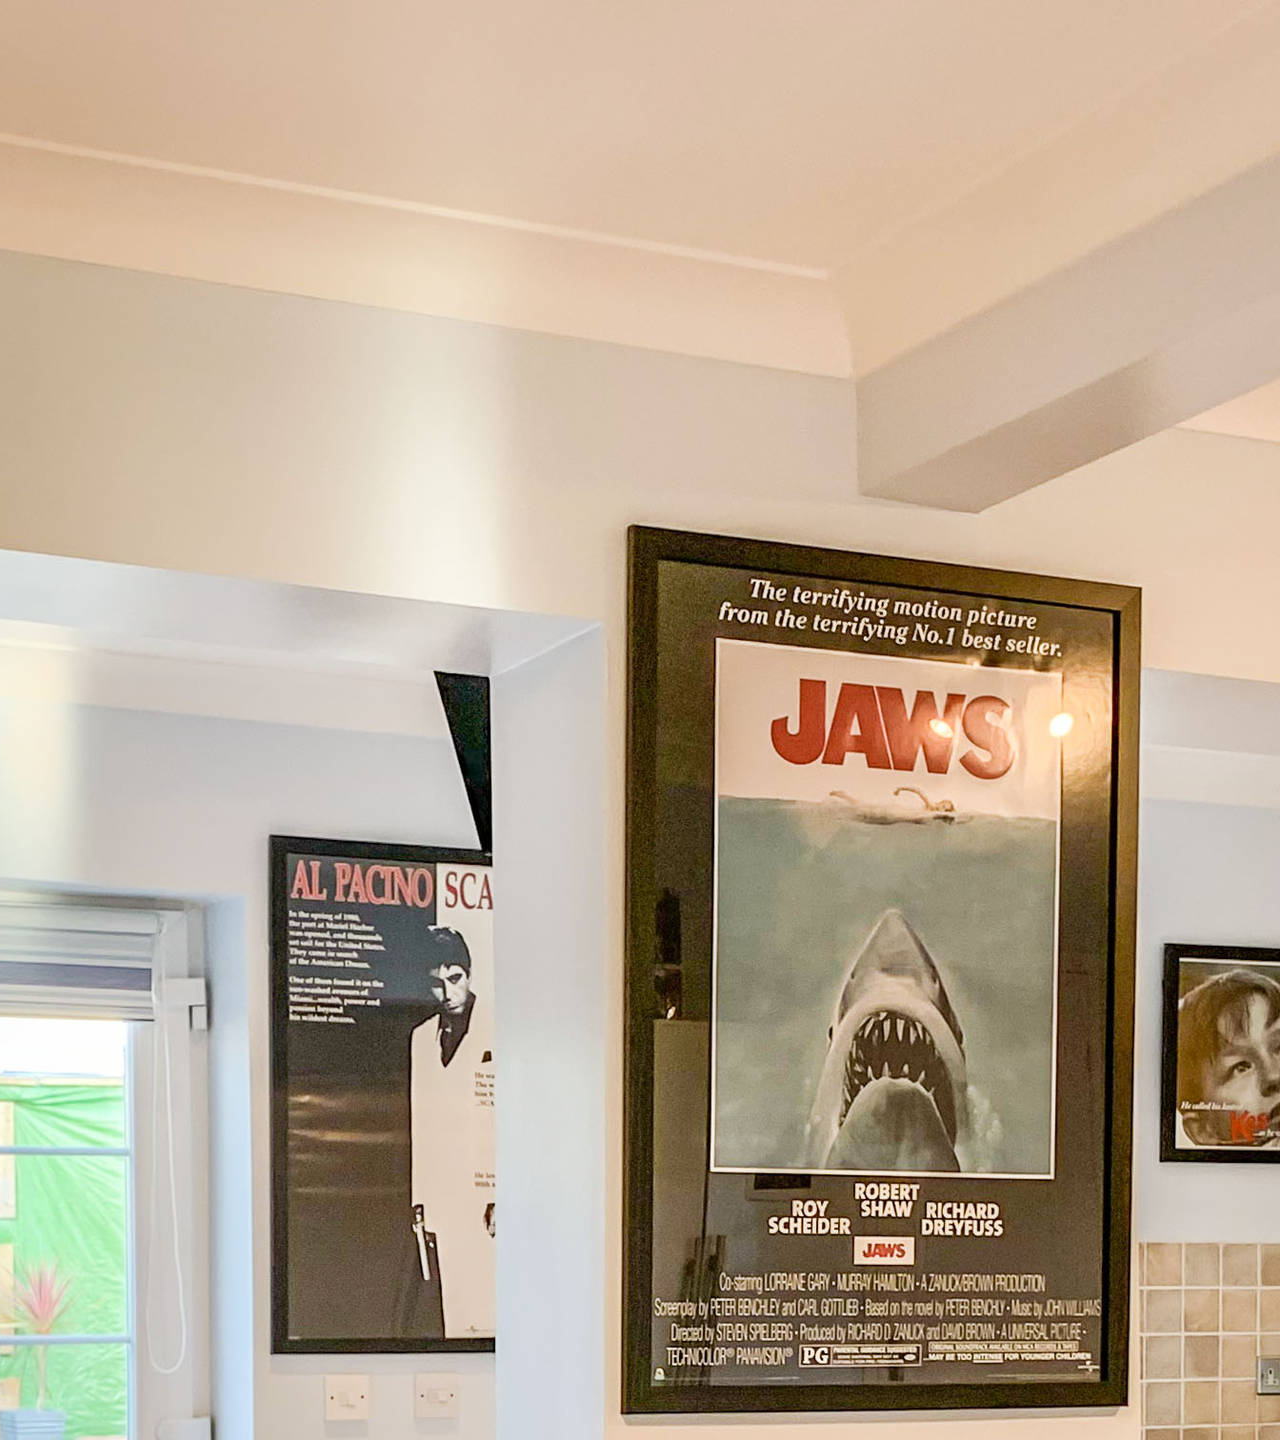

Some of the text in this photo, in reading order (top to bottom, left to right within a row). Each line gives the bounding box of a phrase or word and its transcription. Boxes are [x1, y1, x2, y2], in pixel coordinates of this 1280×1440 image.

[750, 578, 1037, 629] The terrifying motion picture
[718, 601, 1062, 657] from the terrifying No.1 best seller.
[771, 678, 1016, 780] JAWS
[291, 860, 434, 908] AL PACINO
[854, 1183, 920, 1200] ROBERT
[791, 1200, 829, 1217] ROY
[860, 1200, 913, 1217] SHAW
[926, 1202, 1000, 1220] RICHARD
[768, 1217, 851, 1235] SCHEIDER
[921, 1219, 1004, 1236] DREYFUSS
[862, 1243, 906, 1258] JAWS
[719, 1272, 763, 1294] Co-starring
[764, 1272, 806, 1292] LORRAINE
[807, 1272, 830, 1292] GARY
[837, 1272, 872, 1292] MURRAY
[873, 1273, 914, 1292] HAMILTON
[920, 1273, 927, 1292] A
[995, 1273, 1046, 1292] PRODUCTION
[654, 1298, 696, 1319] Screenplay
[698, 1299, 709, 1319] by
[710, 1298, 736, 1316] PETER
[737, 1298, 780, 1316] BENCHLEY
[782, 1299, 796, 1316] and
[797, 1298, 819, 1316] CARL
[821, 1298, 859, 1316] GOTTLIEB
[865, 1298, 888, 1316] Based
[890, 1302, 900, 1316] on
[901, 1300, 913, 1316] the
[914, 1300, 933, 1316] novel
[935, 1300, 944, 1319] by
[945, 1298, 969, 1316] PETER
[1011, 1299, 1032, 1316] Music
[1034, 1300, 1043, 1319] by
[1044, 1299, 1064, 1316] JOHN
[1064, 1299, 1102, 1316] WILLIAMS
[671, 1323, 703, 1341] Directed
[705, 1324, 715, 1344] by
[716, 1323, 747, 1341] STEVEN
[749, 1323, 793, 1341] SPIELBERG
[800, 1323, 835, 1341] Produced
[837, 1323, 846, 1343] by
[847, 1323, 882, 1341] RICHARD
[893, 1323, 925, 1341] ZANUCK
[926, 1324, 940, 1341] and
[941, 1323, 964, 1341] DAVID
[965, 1323, 995, 1341] BROWN
[1001, 1323, 1006, 1340] A
[1008, 1323, 1048, 1340] UNIVERSAL
[1050, 1323, 1081, 1340] PICTURE
[803, 1347, 829, 1364] PG
[973, 1353, 1003, 1361] INTENSE
[1021, 1352, 1055, 1360] YOUNGER
[1055, 1352, 1091, 1360] CHILDREN
